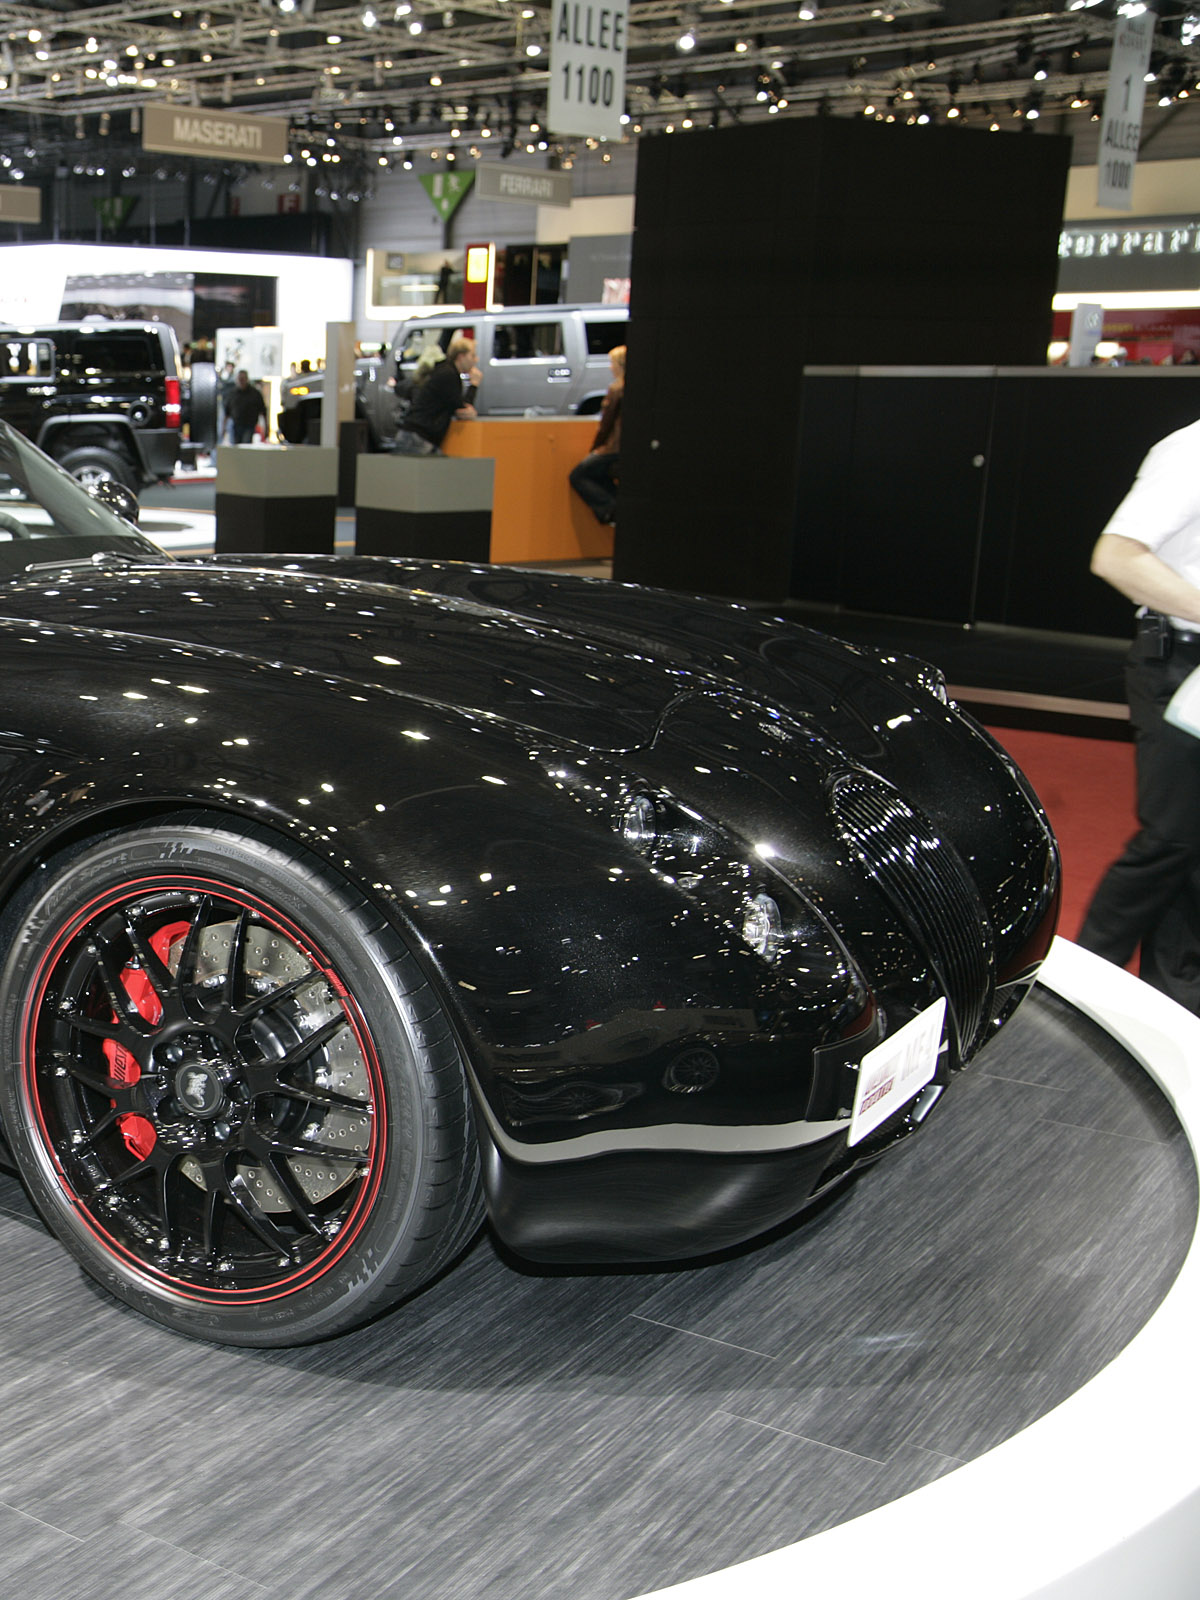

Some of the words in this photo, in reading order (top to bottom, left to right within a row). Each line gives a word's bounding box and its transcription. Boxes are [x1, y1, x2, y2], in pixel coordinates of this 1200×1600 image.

[557, 2, 624, 52] ALLEE
[561, 62, 614, 107] 1100
[173, 116, 263, 150] MASERATI
[1104, 118, 1141, 152] ALLEE
